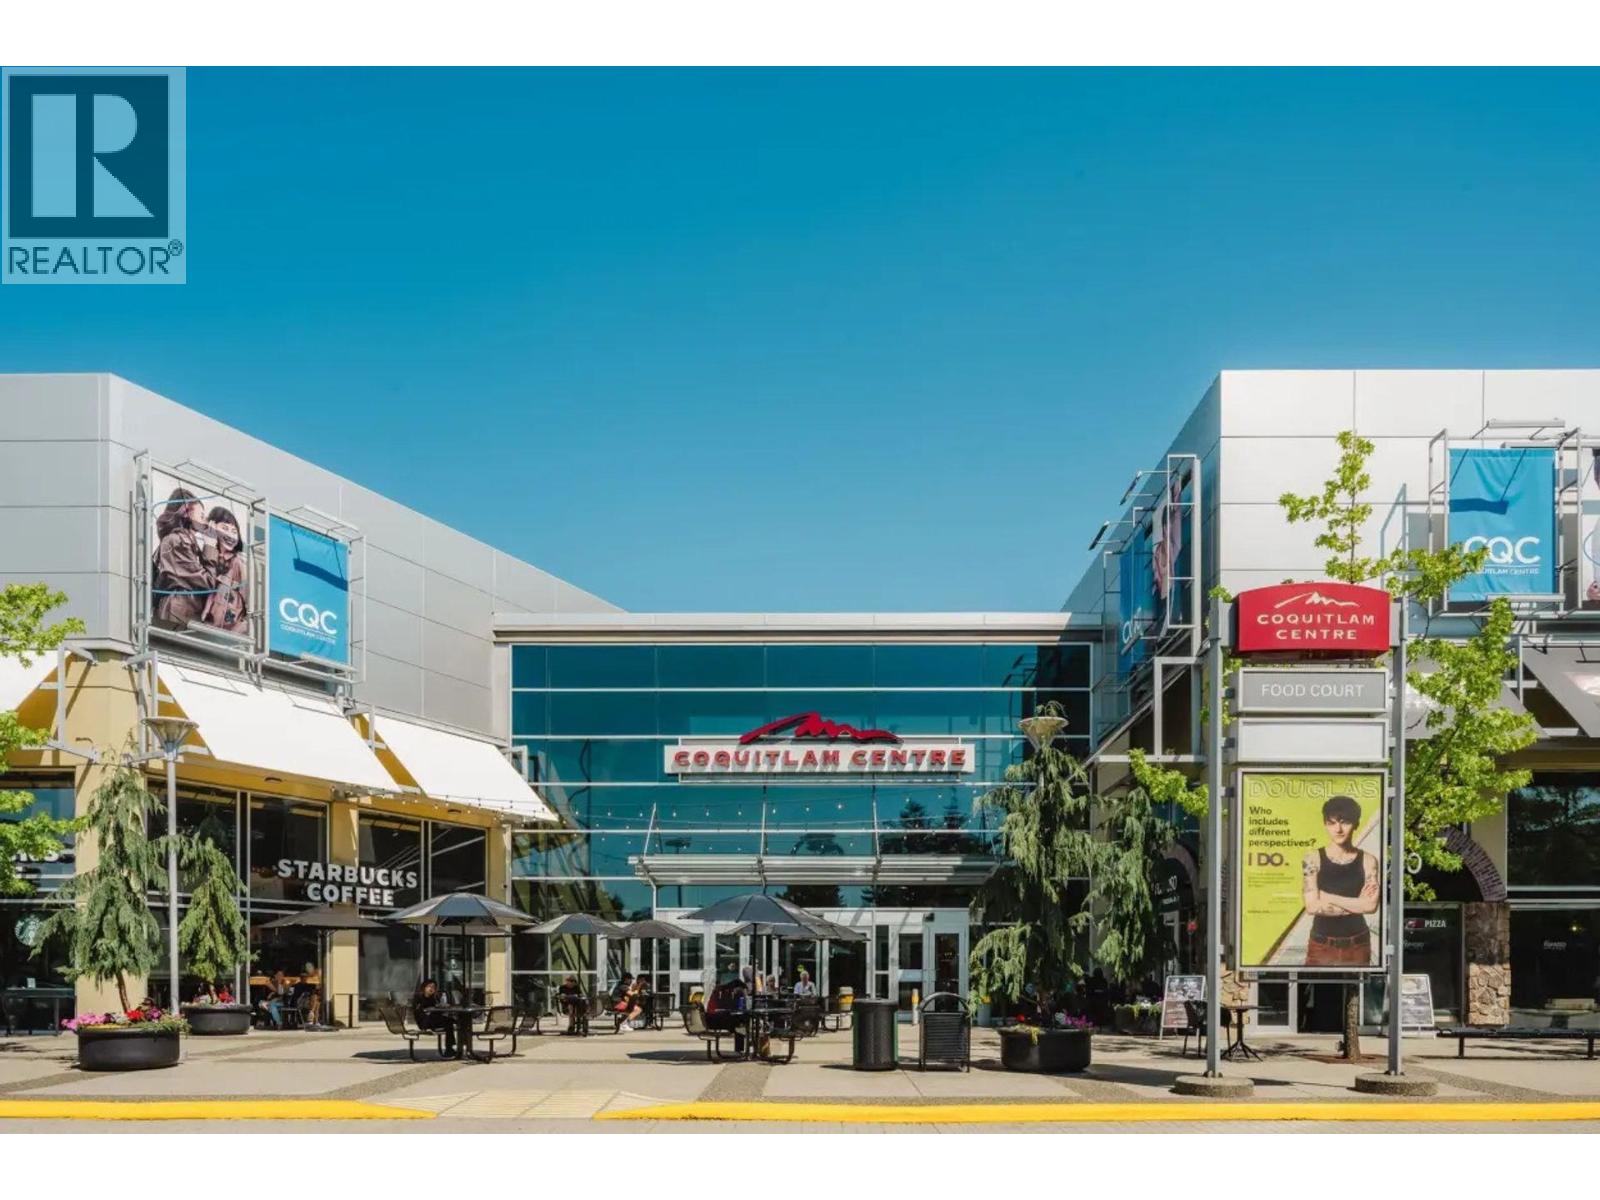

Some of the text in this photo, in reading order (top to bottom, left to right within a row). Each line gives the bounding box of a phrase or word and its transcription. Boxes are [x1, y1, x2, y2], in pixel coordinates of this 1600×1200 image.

[1463, 536, 1541, 564] CQC
[279, 597, 338, 635] CQC
[1257, 614, 1375, 626] COQUITLAM
[1276, 629, 1357, 640] CENTRE
[1262, 684, 1364, 697] FOOD COURT
[674, 750, 966, 767] COQUITLAM CENTRE
[1248, 777, 1379, 799] DOUGLAS
[1249, 806, 1272, 815] Who
[1249, 816, 1289, 825] includes
[1248, 827, 1291, 836] different
[1248, 838, 1317, 848] perspectives?
[1247, 853, 1290, 866] I DO.
[277, 858, 418, 888] STARBUCKS
[306, 882, 394, 906] COFFEE
[1424, 919, 1447, 928] PIZZA
